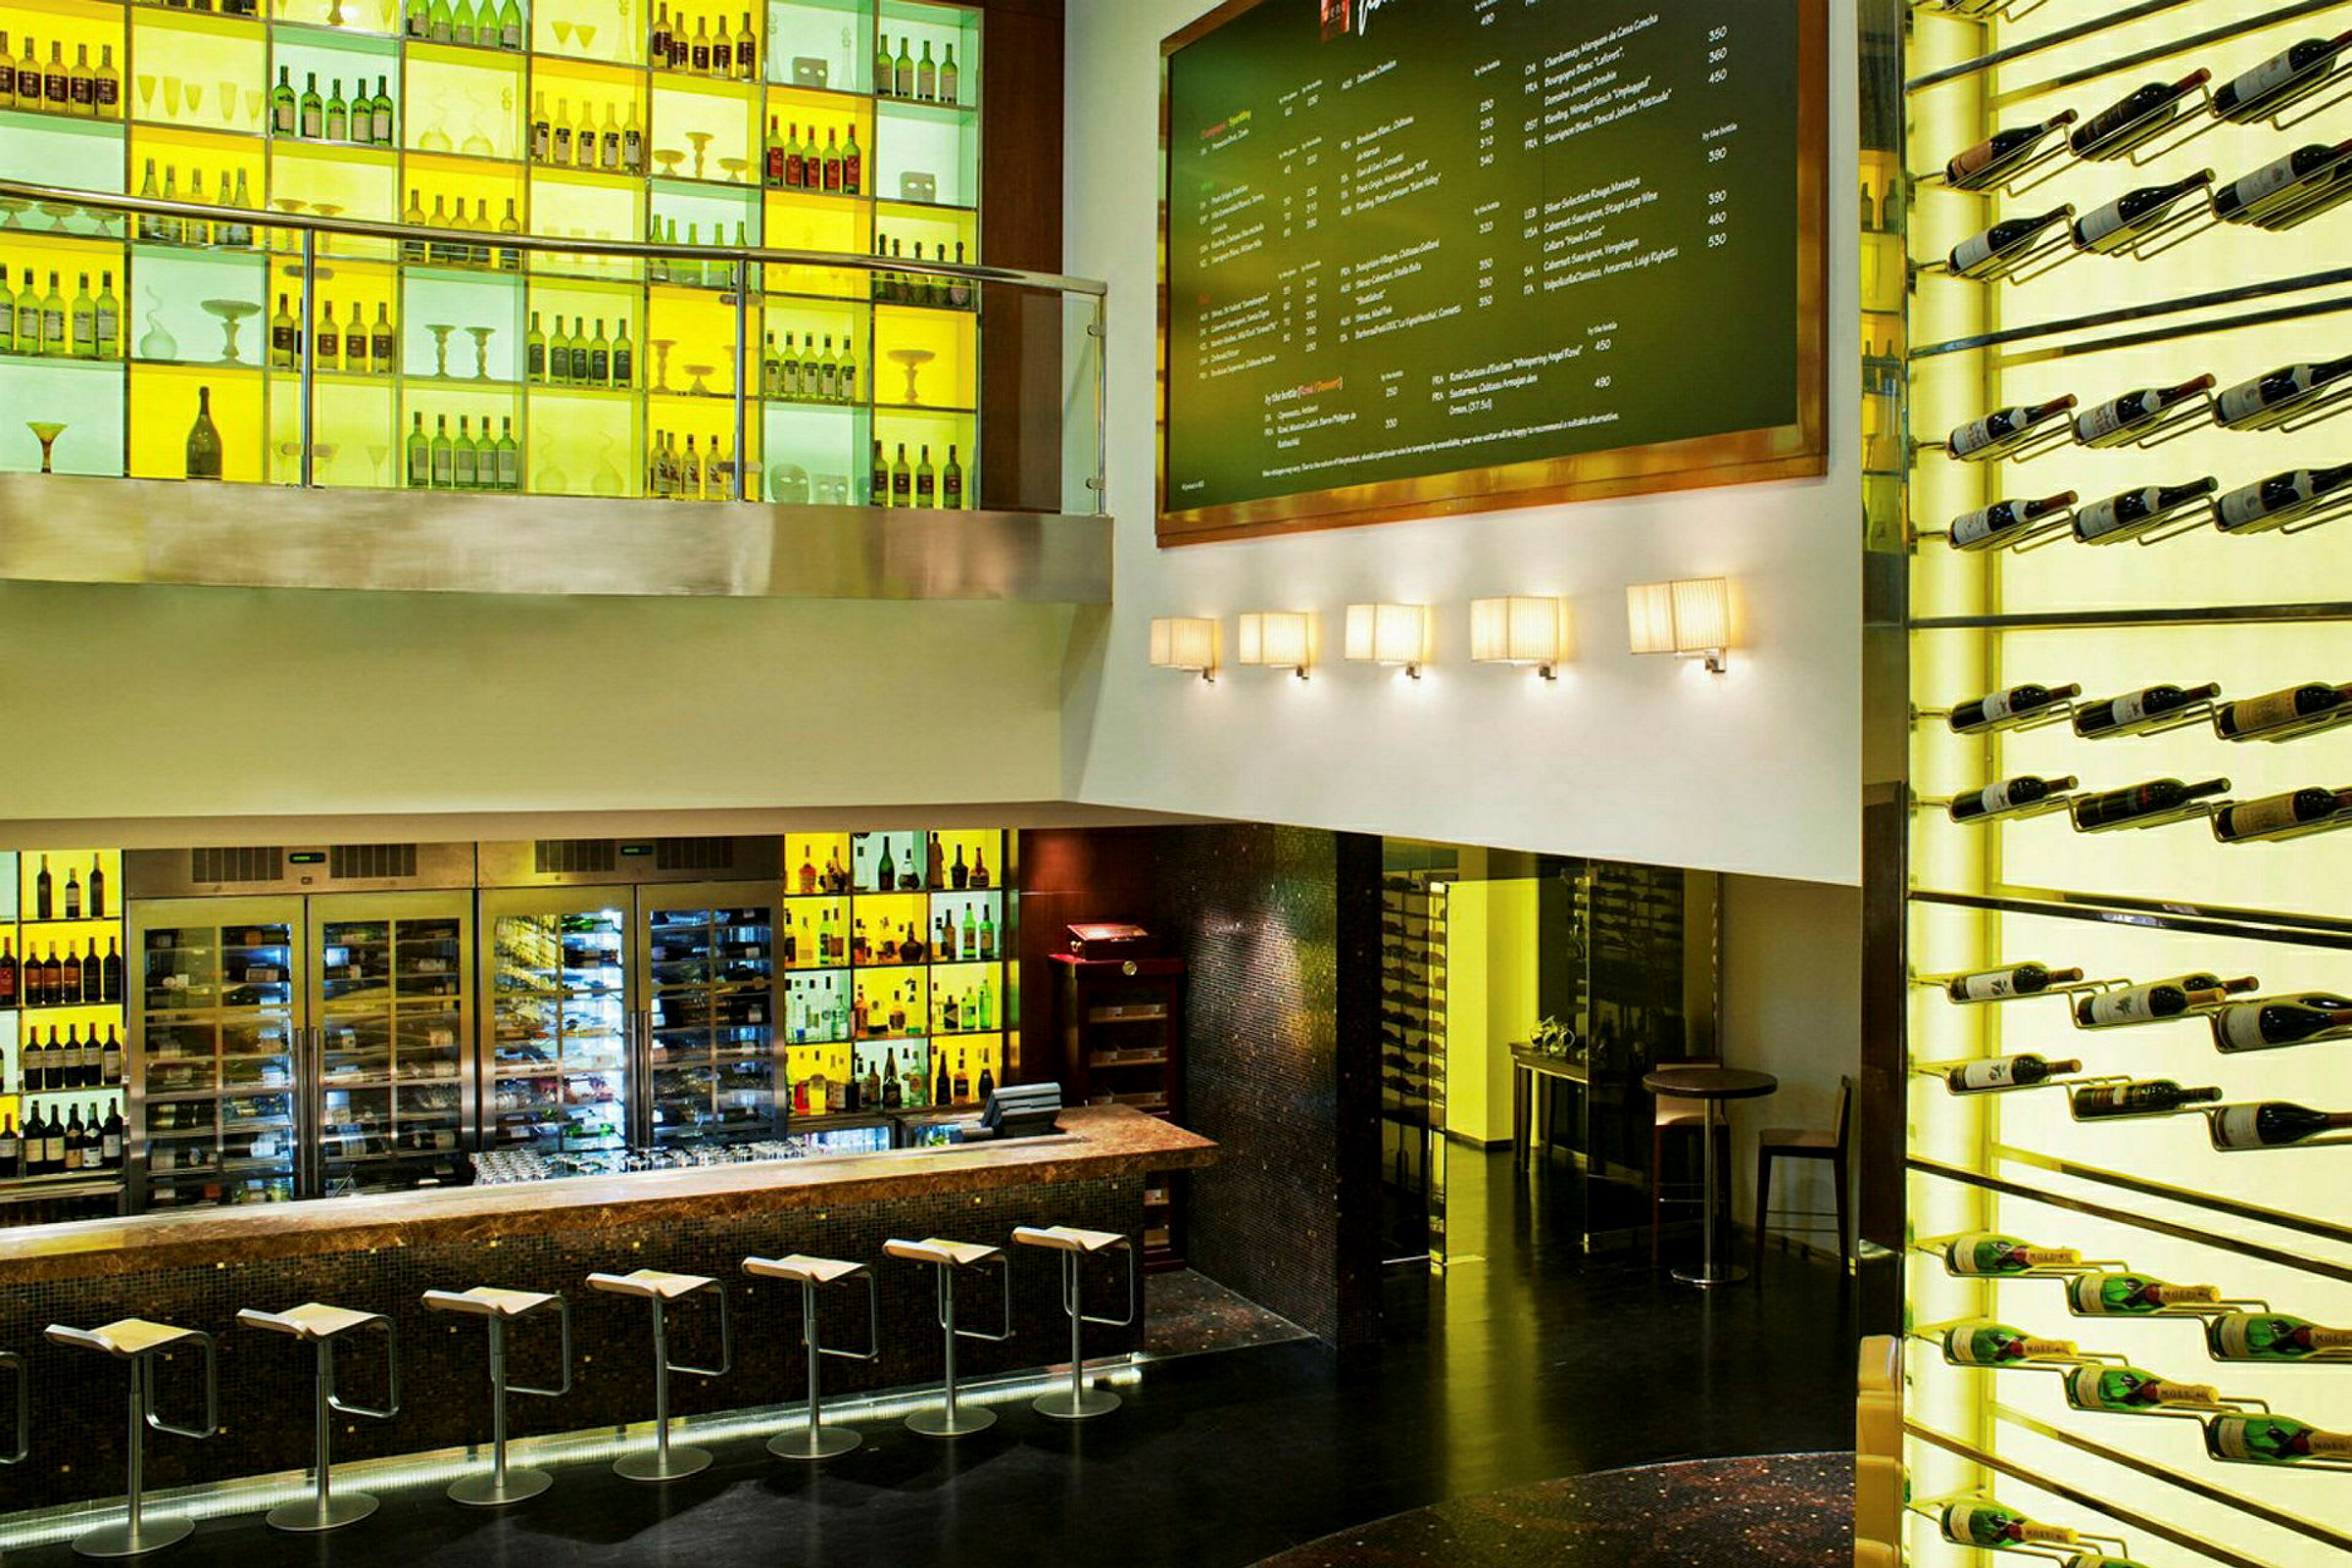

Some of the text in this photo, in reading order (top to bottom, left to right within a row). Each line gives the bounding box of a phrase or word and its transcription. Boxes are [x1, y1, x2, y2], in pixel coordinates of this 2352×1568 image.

[1708, 25, 1727, 41] 350
[1708, 68, 1727, 83] 450
[1525, 81, 1538, 94] FRA
[1525, 138, 1538, 149] FRA
